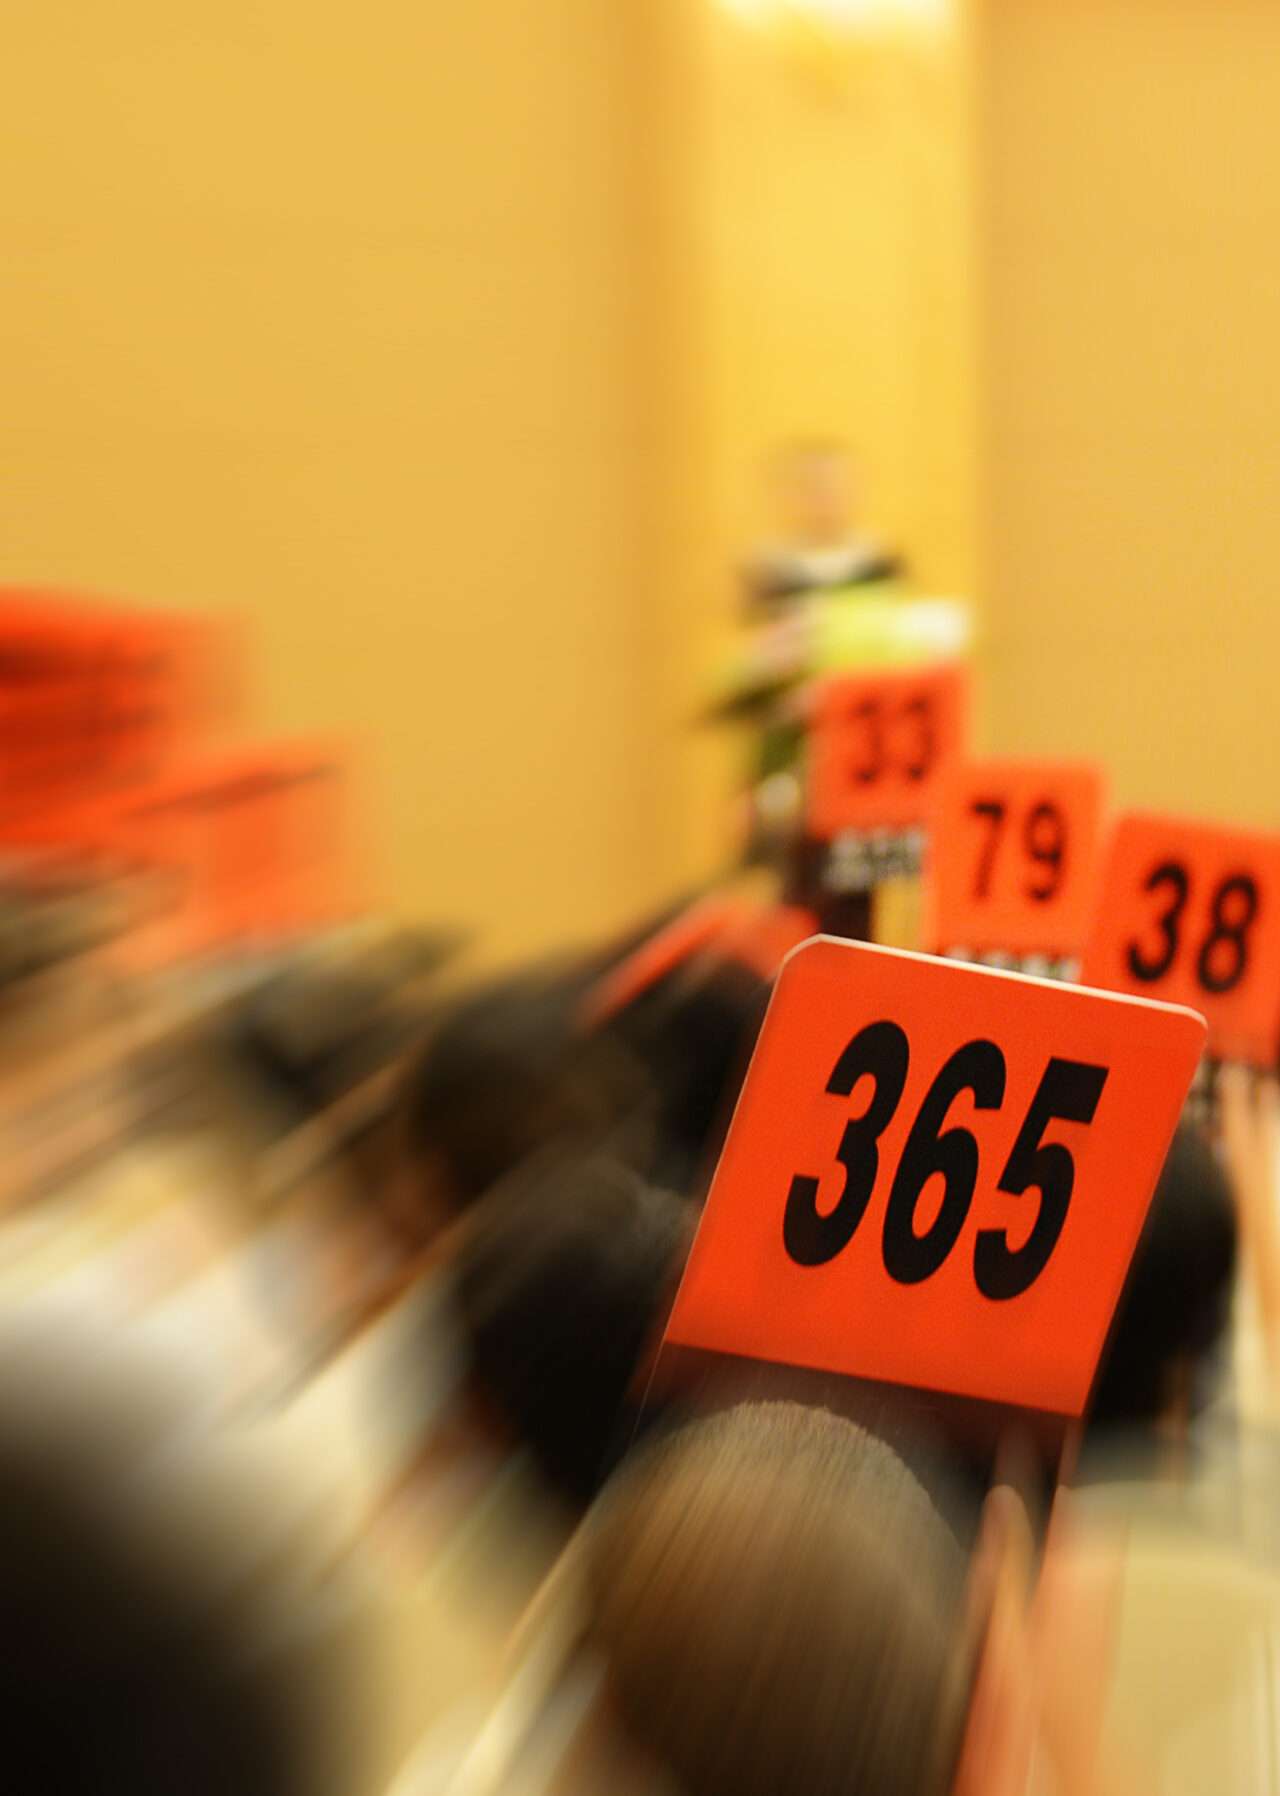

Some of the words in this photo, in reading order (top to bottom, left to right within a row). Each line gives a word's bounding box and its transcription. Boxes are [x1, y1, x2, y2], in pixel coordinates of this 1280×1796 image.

[967, 798, 1066, 903] 79
[1126, 860, 1261, 995] 38
[782, 1020, 1110, 1302] 365
